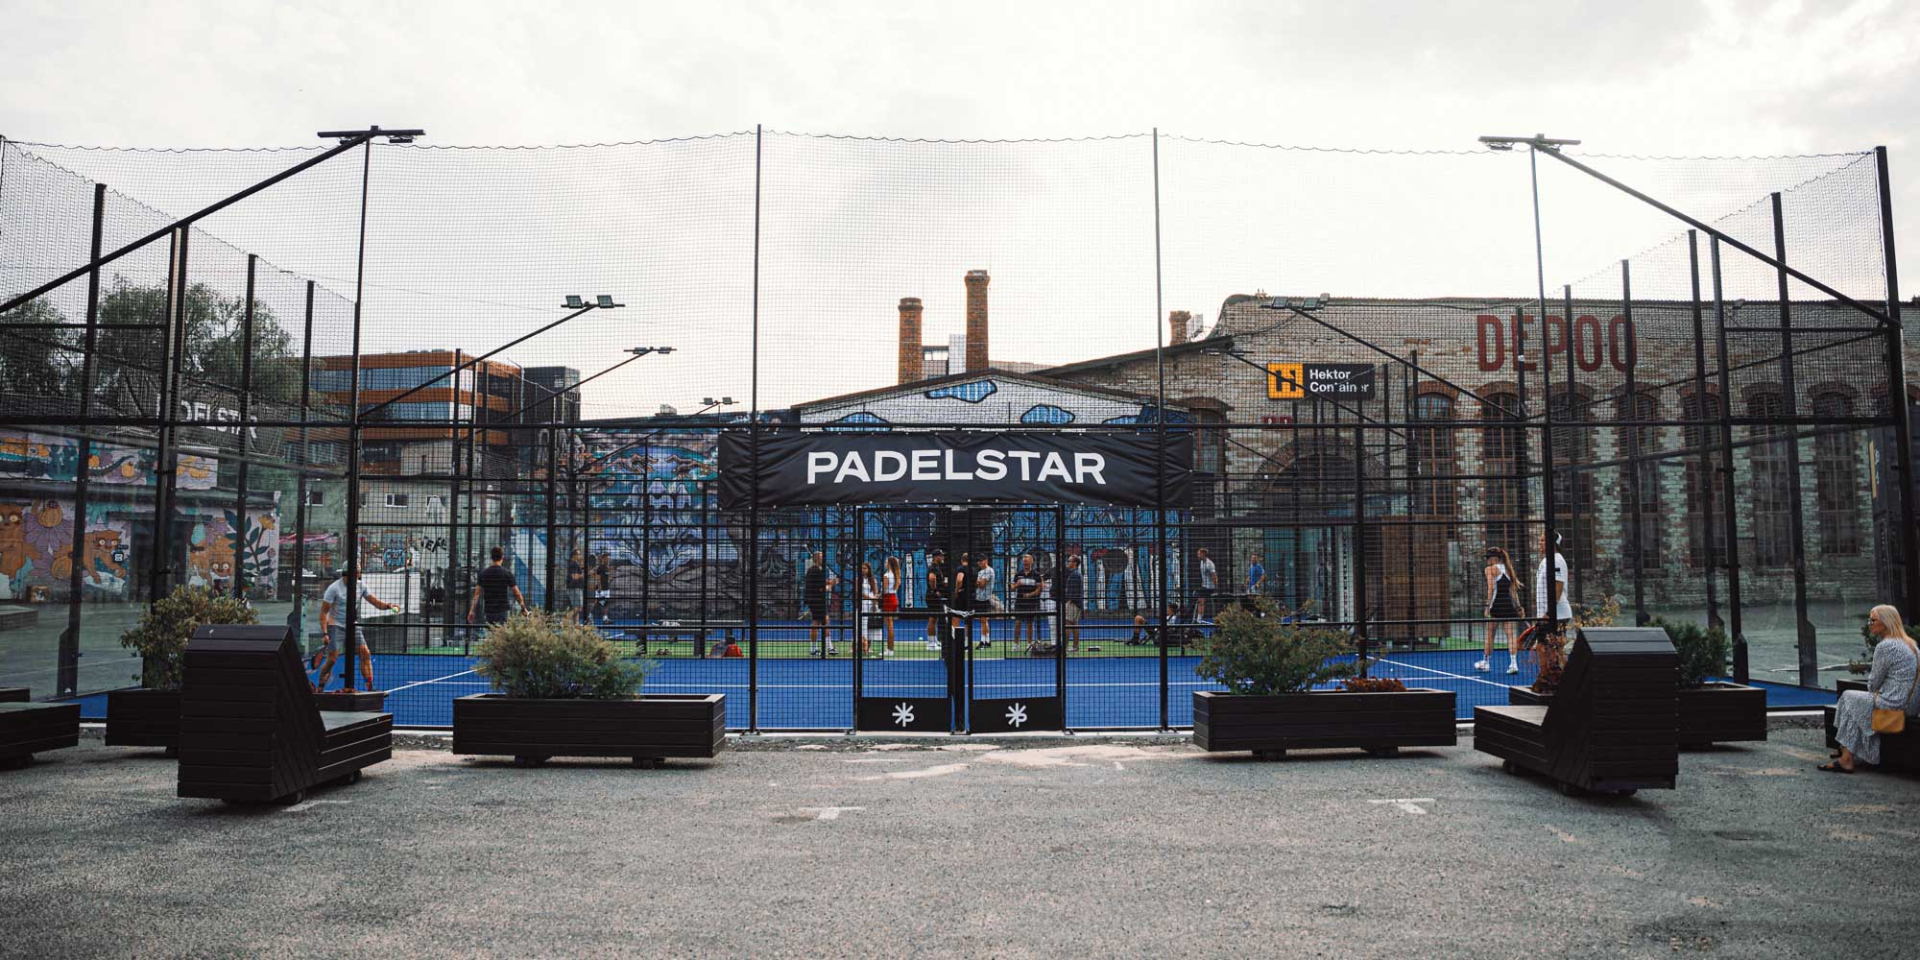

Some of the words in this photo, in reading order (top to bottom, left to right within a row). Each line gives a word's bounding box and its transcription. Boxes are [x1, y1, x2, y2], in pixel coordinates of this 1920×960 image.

[1477, 315, 1638, 372] DEPOO
[1309, 368, 1351, 380] Hektor
[1309, 381, 1370, 393] Conainr
[807, 449, 1107, 484] PADELSTAR
